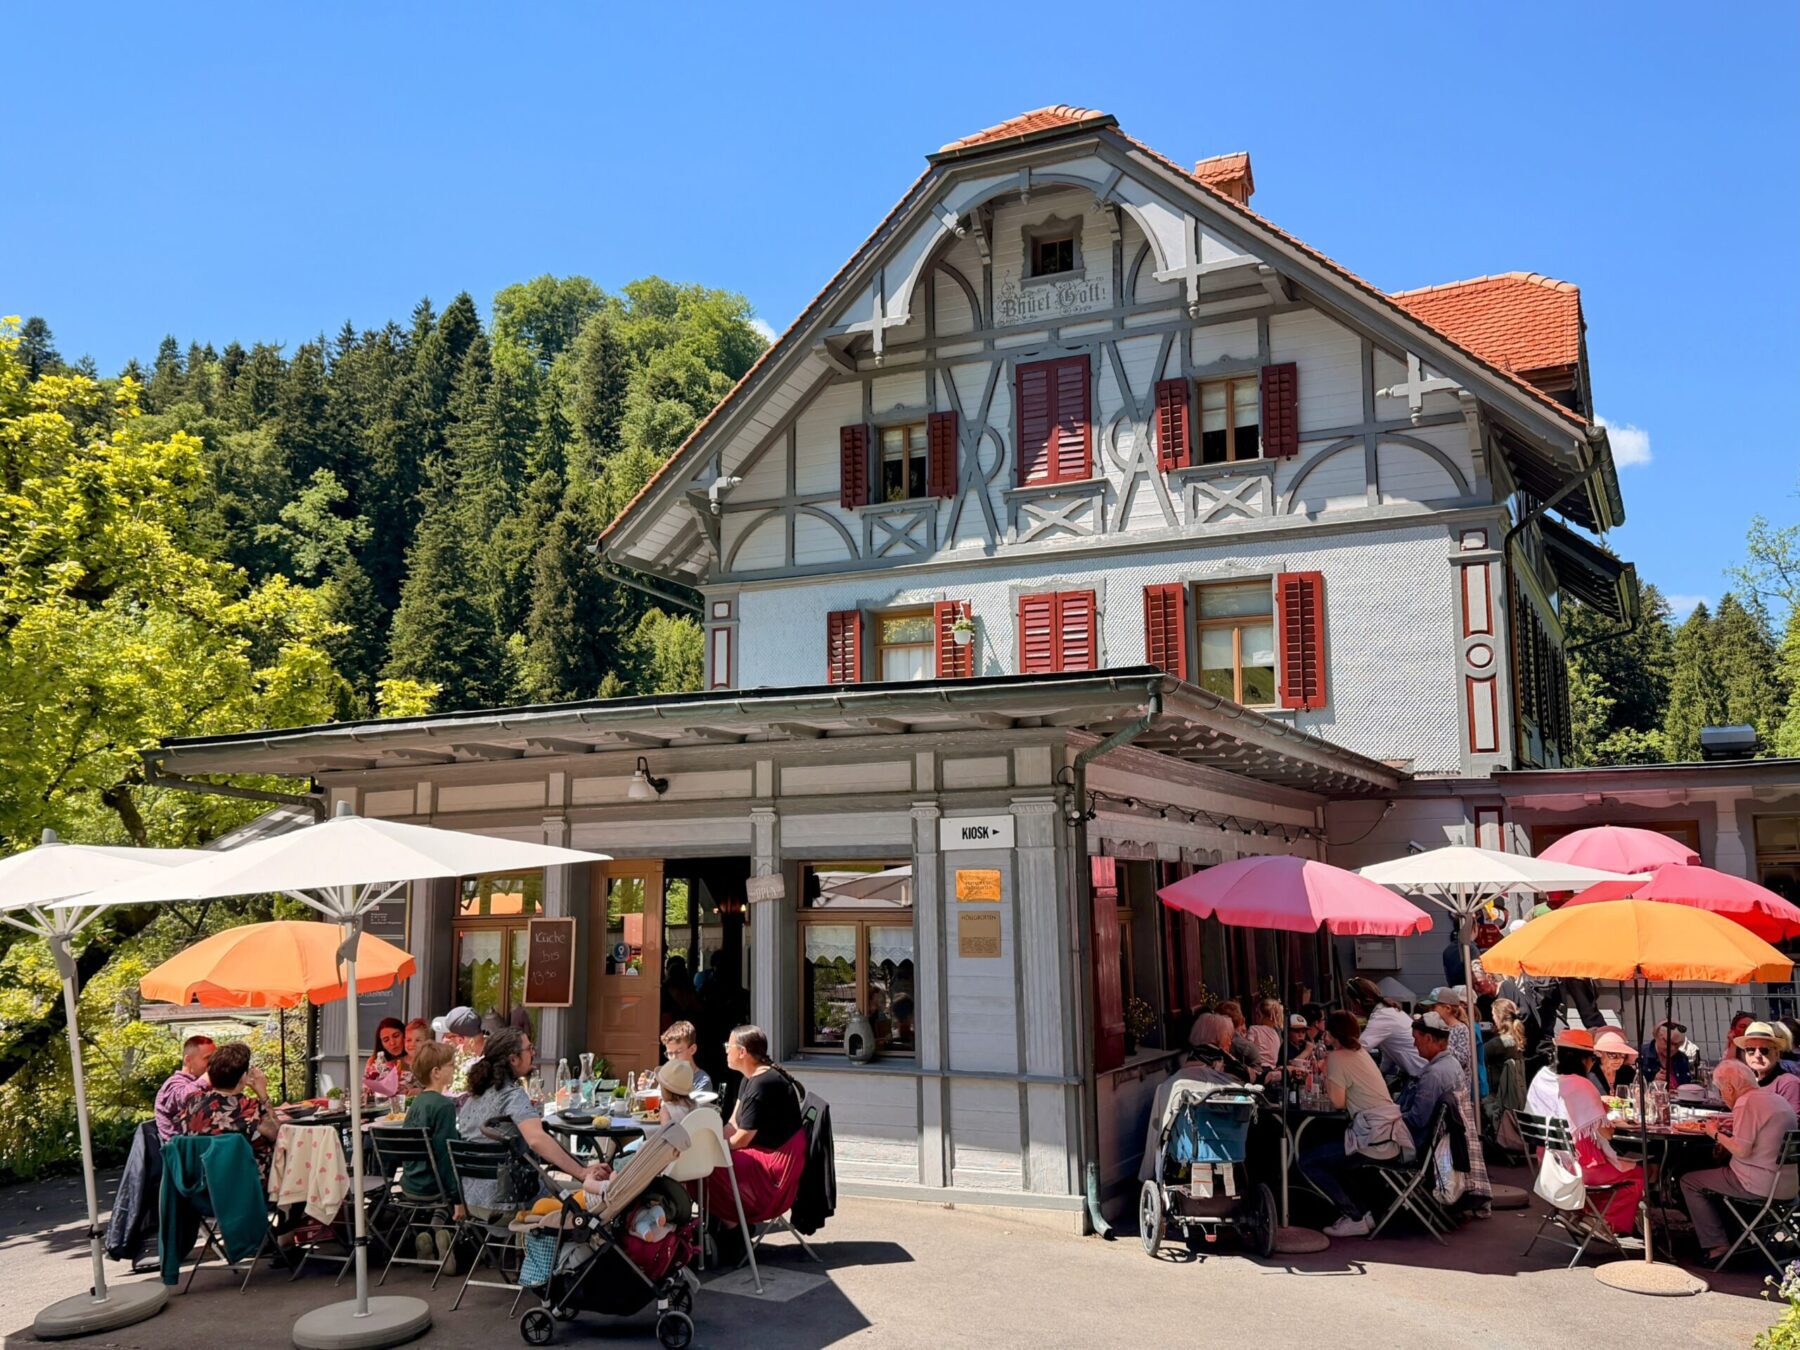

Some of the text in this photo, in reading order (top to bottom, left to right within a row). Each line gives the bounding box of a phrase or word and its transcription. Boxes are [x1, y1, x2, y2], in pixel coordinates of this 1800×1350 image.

[962, 826, 989, 840] KIOSK
[535, 930, 566, 944] Küche
[540, 949, 560, 963] bis
